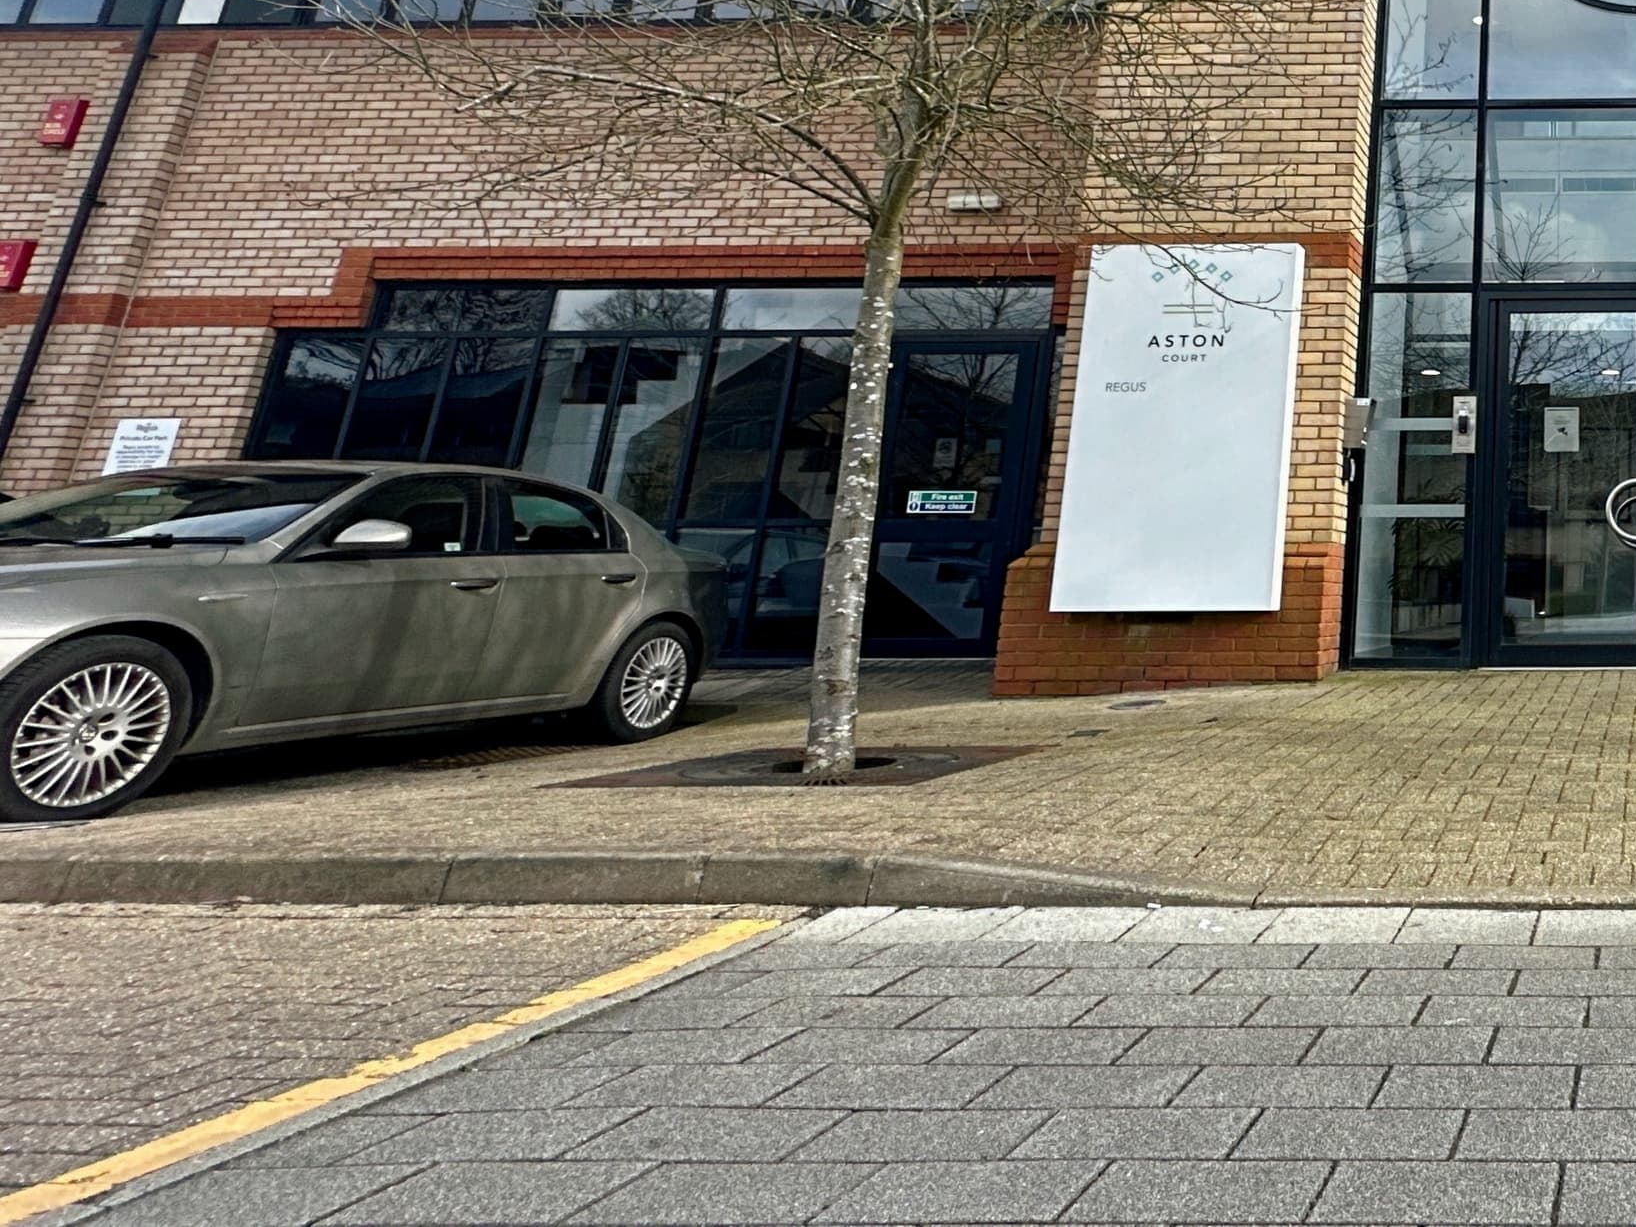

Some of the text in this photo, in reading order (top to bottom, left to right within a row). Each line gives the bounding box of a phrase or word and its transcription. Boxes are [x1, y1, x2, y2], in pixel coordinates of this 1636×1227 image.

[1148, 334, 1224, 348] ASTON
[1161, 354, 1207, 363] COURT
[1105, 381, 1147, 393] REGUS
